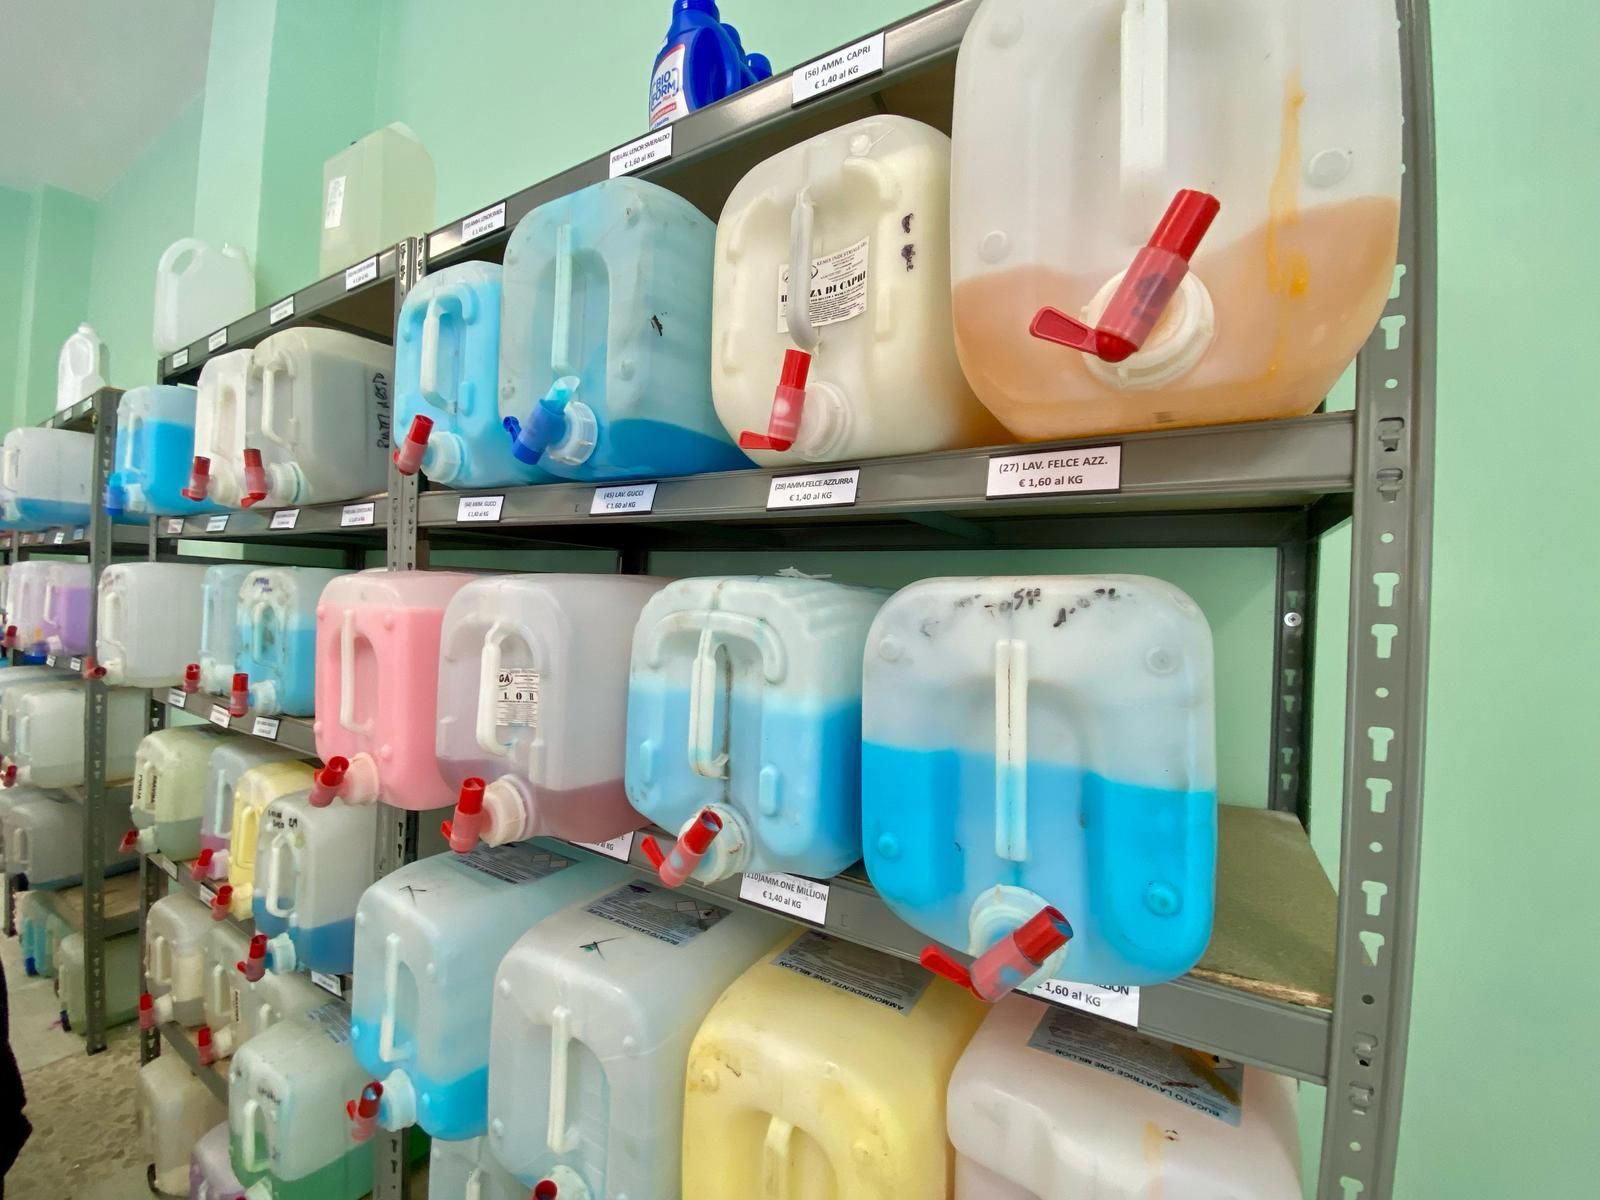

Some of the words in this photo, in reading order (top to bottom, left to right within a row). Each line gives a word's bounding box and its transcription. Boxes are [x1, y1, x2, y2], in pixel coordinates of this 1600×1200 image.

[804, 67, 819, 80] (56)
[821, 57, 845, 73] AMM.
[846, 45, 871, 61] CAPRI
[656, 70, 671, 89] BIO
[814, 81, 820, 89] €
[821, 74, 837, 87] 1,40
[838, 71, 846, 79] al
[848, 65, 859, 75] KG
[651, 80, 676, 105] FORM
[825, 284, 837, 294] DI
[839, 270, 866, 290] CAPRI
[999, 463, 1020, 474] (27)
[1022, 461, 1044, 471] LAV.
[1047, 457, 1080, 469] FELCE
[1082, 456, 1108, 467] AZZ.
[823, 477, 854, 486] AZZURRA
[1018, 478, 1026, 488] €
[1028, 477, 1051, 489] 1,60
[1054, 476, 1065, 486] al
[1068, 475, 1084, 485] KG
[795, 493, 812, 502] 1,40
[821, 491, 832, 499] KG
[499, 674, 510, 683] GA
[762, 890, 768, 898] €
[768, 892, 783, 902] 1,40
[784, 897, 791, 905] al
[791, 900, 802, 909] KG
[796, 885, 827, 901] MILLION
[832, 981, 905, 1011] AMMORBIDENTE
[1045, 982, 1069, 997] 1,60
[1071, 991, 1082, 1000] al
[1086, 994, 1101, 1007] KG
[1095, 1062, 1115, 1073] ONE
[1118, 1070, 1173, 1096] LAVATRICE
[1175, 1094, 1220, 1117] BUCATO
